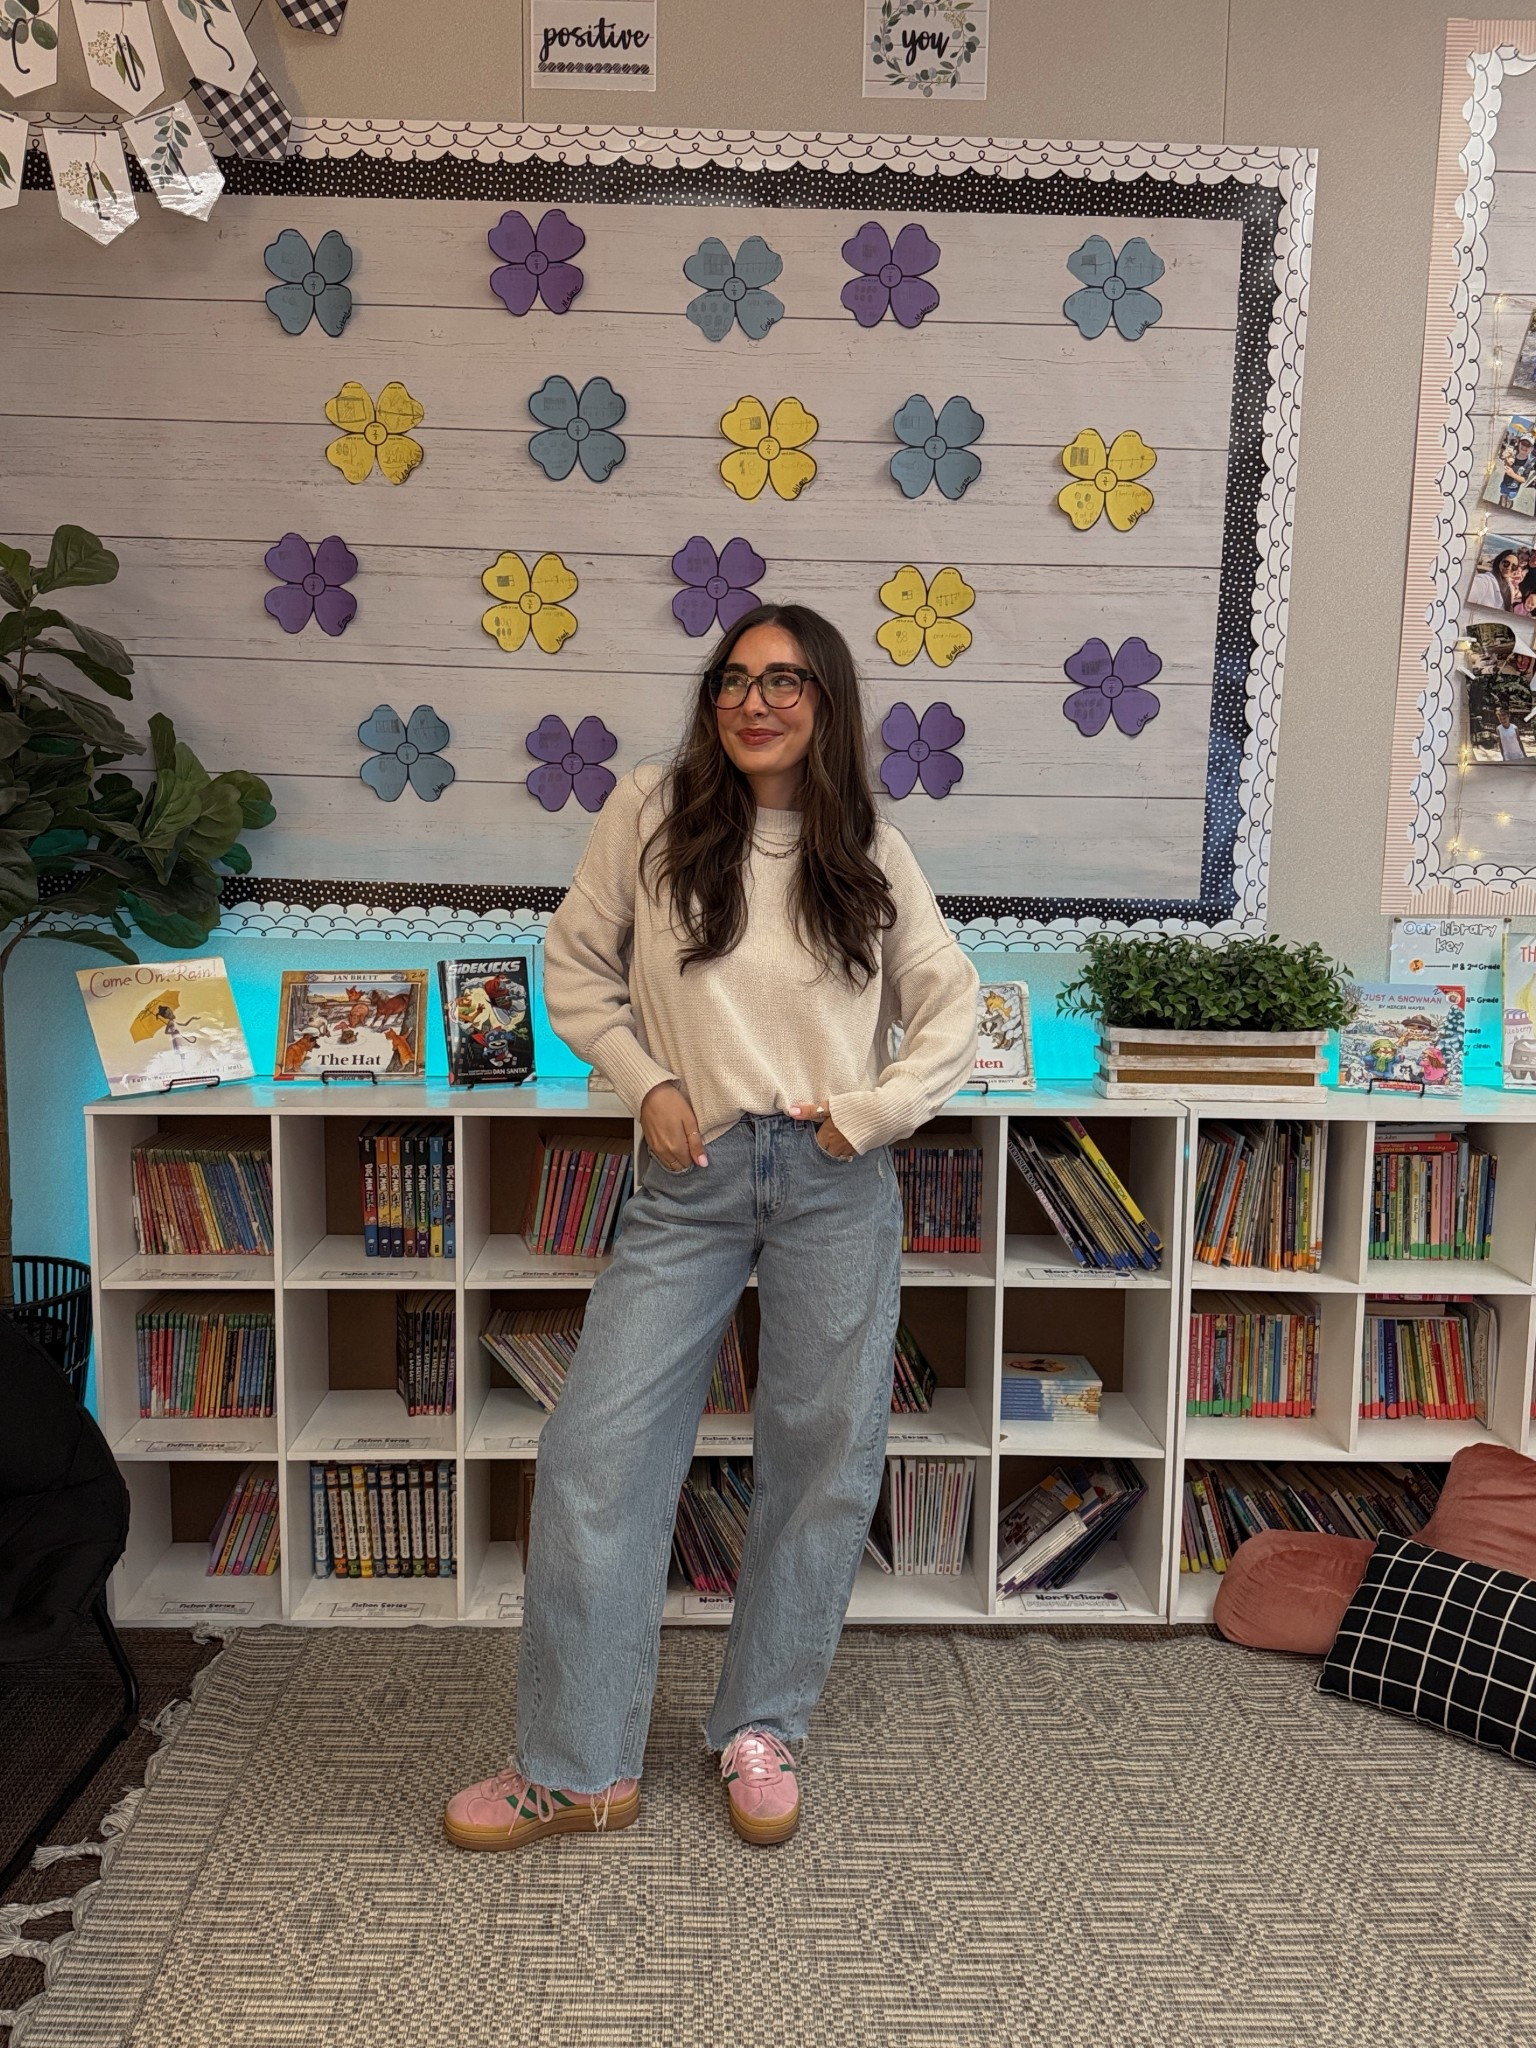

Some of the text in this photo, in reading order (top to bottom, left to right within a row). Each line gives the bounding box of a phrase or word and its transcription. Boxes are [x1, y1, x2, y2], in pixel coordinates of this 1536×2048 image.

[538, 17, 651, 62] positive
[901, 28, 950, 66] you
[1136, 320, 1149, 335] Luke
[955, 475, 972, 493] Logan
[1127, 507, 1146, 525] MYLA
[555, 629, 570, 645] Noah
[945, 643, 966, 661] Bradley
[1403, 920, 1497, 938] Our Library
[1435, 938, 1464, 955] Key
[1520, 946, 1536, 963] TH
[89, 971, 133, 998] Come
[175, 959, 217, 982] Rain!
[1363, 994, 1386, 1002] JUST
[1397, 995, 1442, 1004] SNOWMAN
[1476, 996, 1499, 1004] Grade
[317, 1054, 381, 1066] The Hat
[974, 1059, 1004, 1069] tten
[365, 1163, 373, 1191] DOG MAN
[378, 1164, 388, 1190] DOG MAN
[391, 1164, 400, 1192] DOG MAN
[404, 1164, 413, 1177] DOG
[418, 1164, 427, 1177] DOG
[432, 1164, 441, 1191] DOG MAN
[446, 1165, 454, 1178] DOG
[418, 1179, 426, 1192] MAN
